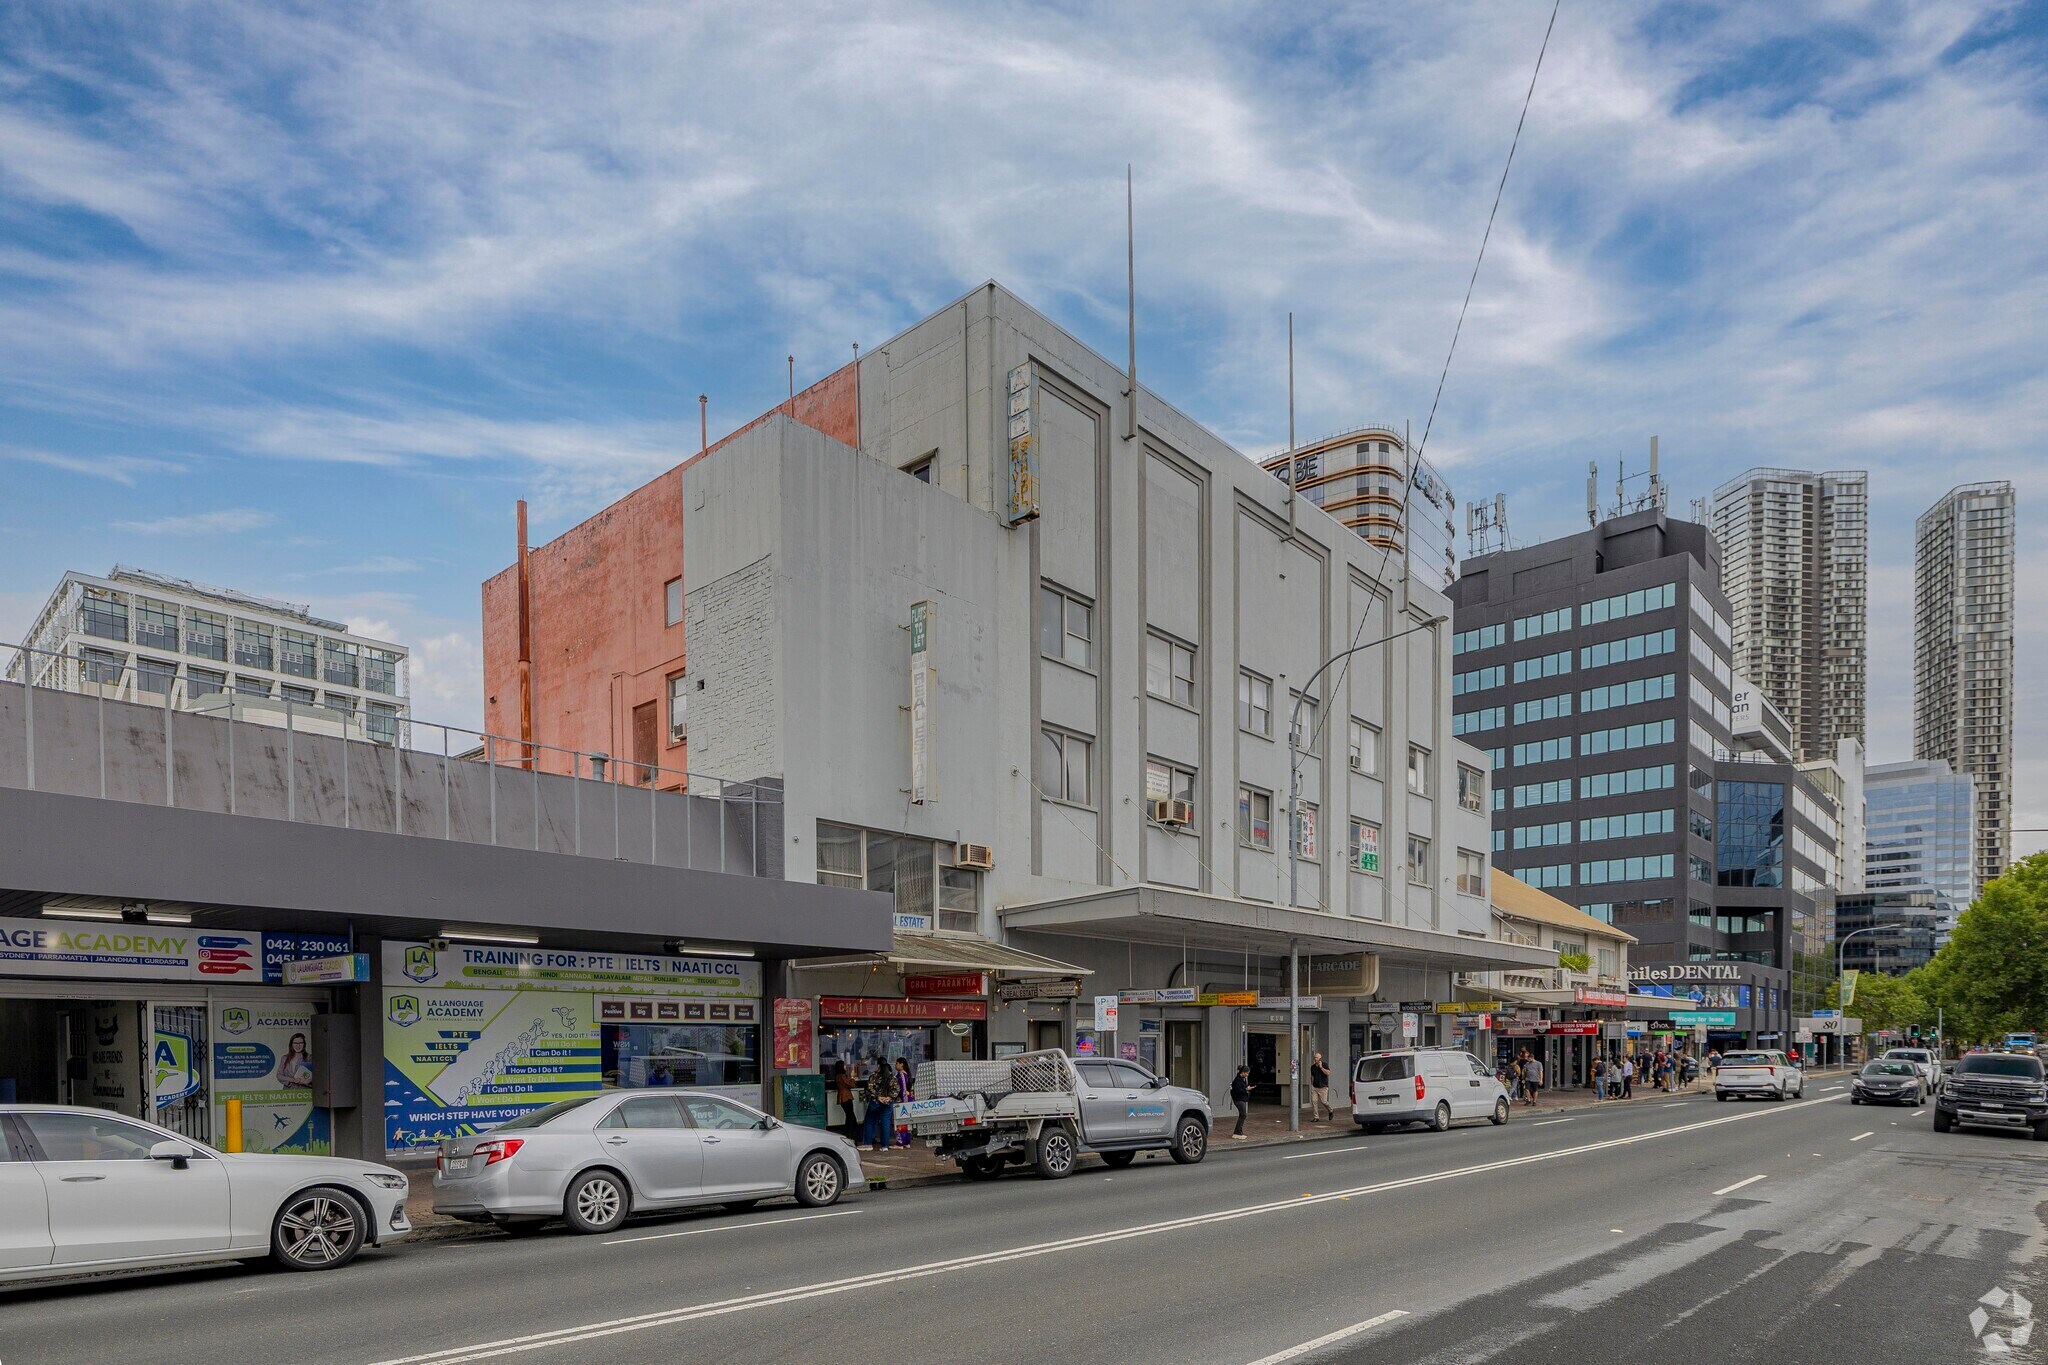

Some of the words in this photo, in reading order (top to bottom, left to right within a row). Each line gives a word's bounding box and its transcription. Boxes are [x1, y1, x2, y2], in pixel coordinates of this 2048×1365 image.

[911, 605, 927, 624] FLATS
[914, 622, 923, 635] TO
[913, 633, 925, 649] LET
[900, 916, 925, 929] ESTATE
[54, 932, 188, 955] ACADEMY
[301, 940, 325, 952] 230
[326, 942, 350, 953] 061
[38, 954, 88, 962] PARRAMATTA
[95, 956, 138, 964] JALANDHAR
[144, 958, 186, 966] GURDASPUR
[412, 950, 429, 964] LA
[462, 949, 543, 966] TRAINING
[547, 954, 577, 968] FOR
[588, 956, 614, 970] PTE
[626, 958, 661, 972] IELTS
[672, 960, 712, 974] NAATI
[715, 963, 740, 975] CCL
[473, 968, 502, 976] BENGALI
[505, 970, 539, 978] GUJARATI
[910, 980, 927, 989] CHAI
[937, 978, 977, 988] PARANTHA
[396, 1000, 413, 1010] LA
[439, 1000, 484, 1008] LANGUAGE
[838, 1002, 863, 1013] CHAI
[877, 1004, 928, 1015] PARANTHA
[228, 1012, 244, 1020] LA
[427, 1008, 484, 1017] ACADEMY
[256, 1018, 310, 1026] ACADEMY
[1822, 1021, 1838, 1030] 80
[160, 1090, 189, 1101] ACADEMY
[476, 1096, 500, 1104] Won't
[912, 1100, 946, 1110] ANCORP
[408, 1112, 445, 1122] WHICH
[446, 1111, 470, 1120] STEP
[472, 1110, 497, 1119] HAVE
[499, 1109, 518, 1118] YOU
